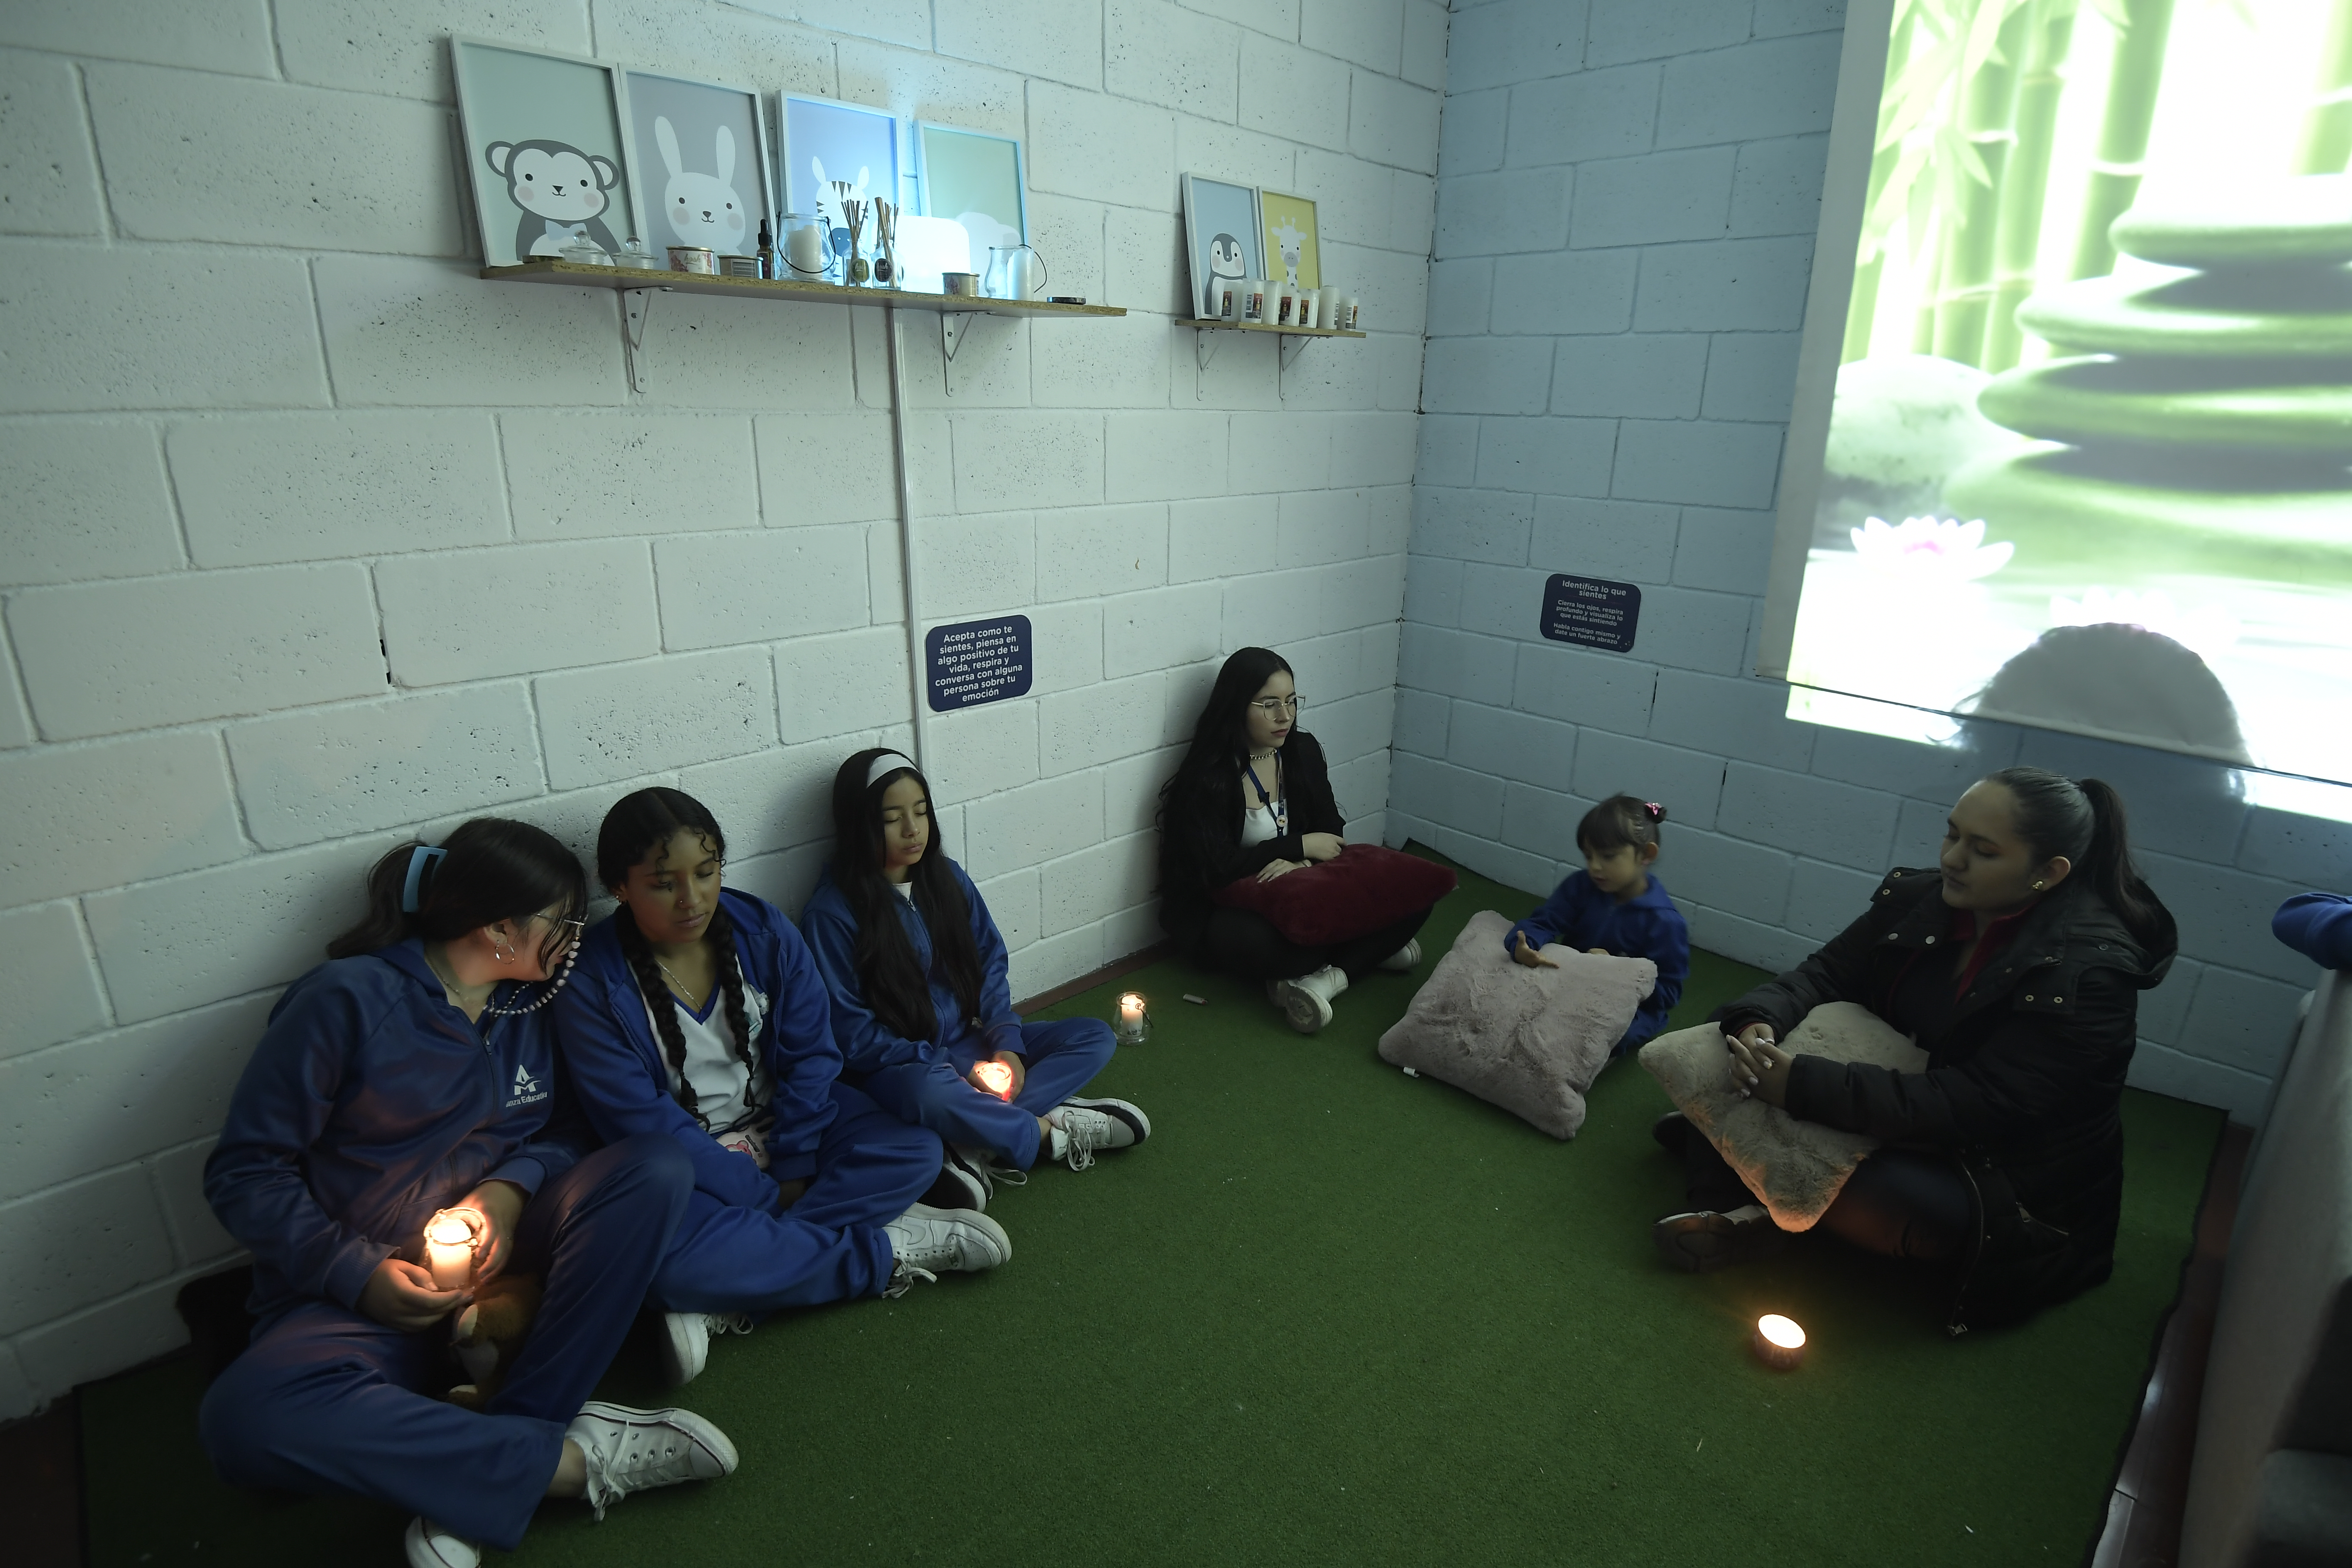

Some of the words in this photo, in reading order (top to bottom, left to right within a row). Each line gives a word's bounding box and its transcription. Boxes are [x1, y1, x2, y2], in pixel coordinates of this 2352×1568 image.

[1563, 580, 1598, 591] Identifica
[1611, 588, 1626, 596] que
[1579, 590, 1606, 599] sientes
[1556, 605, 1583, 614] profundo
[1590, 610, 1615, 620] visualiza
[1589, 616, 1617, 626] sintiendo
[944, 631, 975, 643] Acepta
[977, 628, 1002, 637] como
[1004, 626, 1012, 634] te
[1571, 626, 1594, 634] contigo
[1595, 629, 1615, 638] mismo
[1597, 636, 1617, 644] abrazo
[939, 642, 974, 654] sientes,
[976, 637, 1004, 649] piensa
[938, 655, 958, 665] algo
[960, 649, 995, 662] positivo
[997, 646, 1008, 655] de
[949, 663, 970, 673] vida,
[973, 658, 1002, 670] respira
[1004, 657, 1010, 665] y
[935, 674, 975, 686] conversa
[977, 670, 992, 679] con
[995, 664, 1023, 675] alguna
[944, 682, 979, 697] persona
[981, 677, 1005, 688] sobre
[962, 688, 999, 702] emoción
